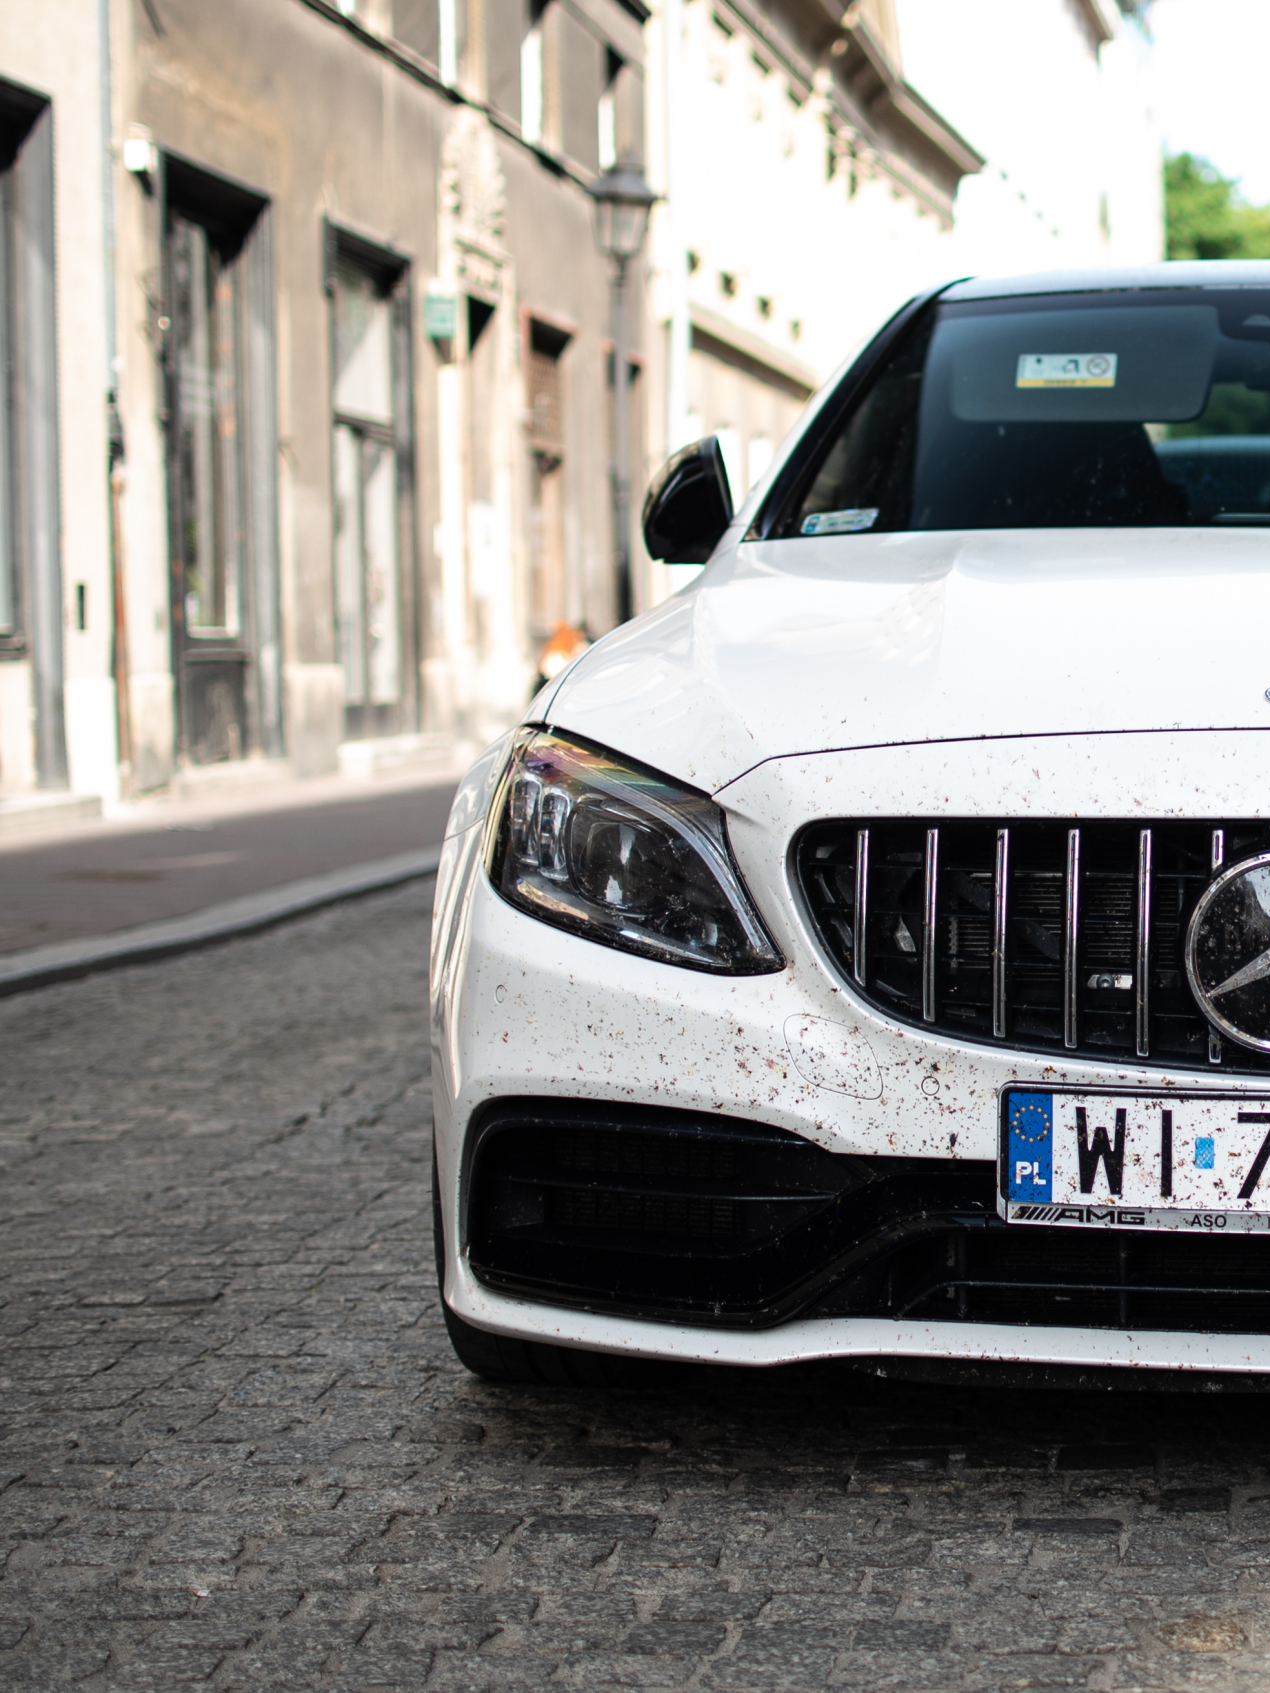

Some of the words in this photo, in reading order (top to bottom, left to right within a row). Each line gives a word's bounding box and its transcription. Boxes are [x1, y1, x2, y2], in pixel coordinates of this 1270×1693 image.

[1075, 1106, 1173, 1197] WI
[1015, 1160, 1047, 1186] PL
[1050, 1208, 1145, 1226] AMG
[1190, 1214, 1227, 1228] ASO
